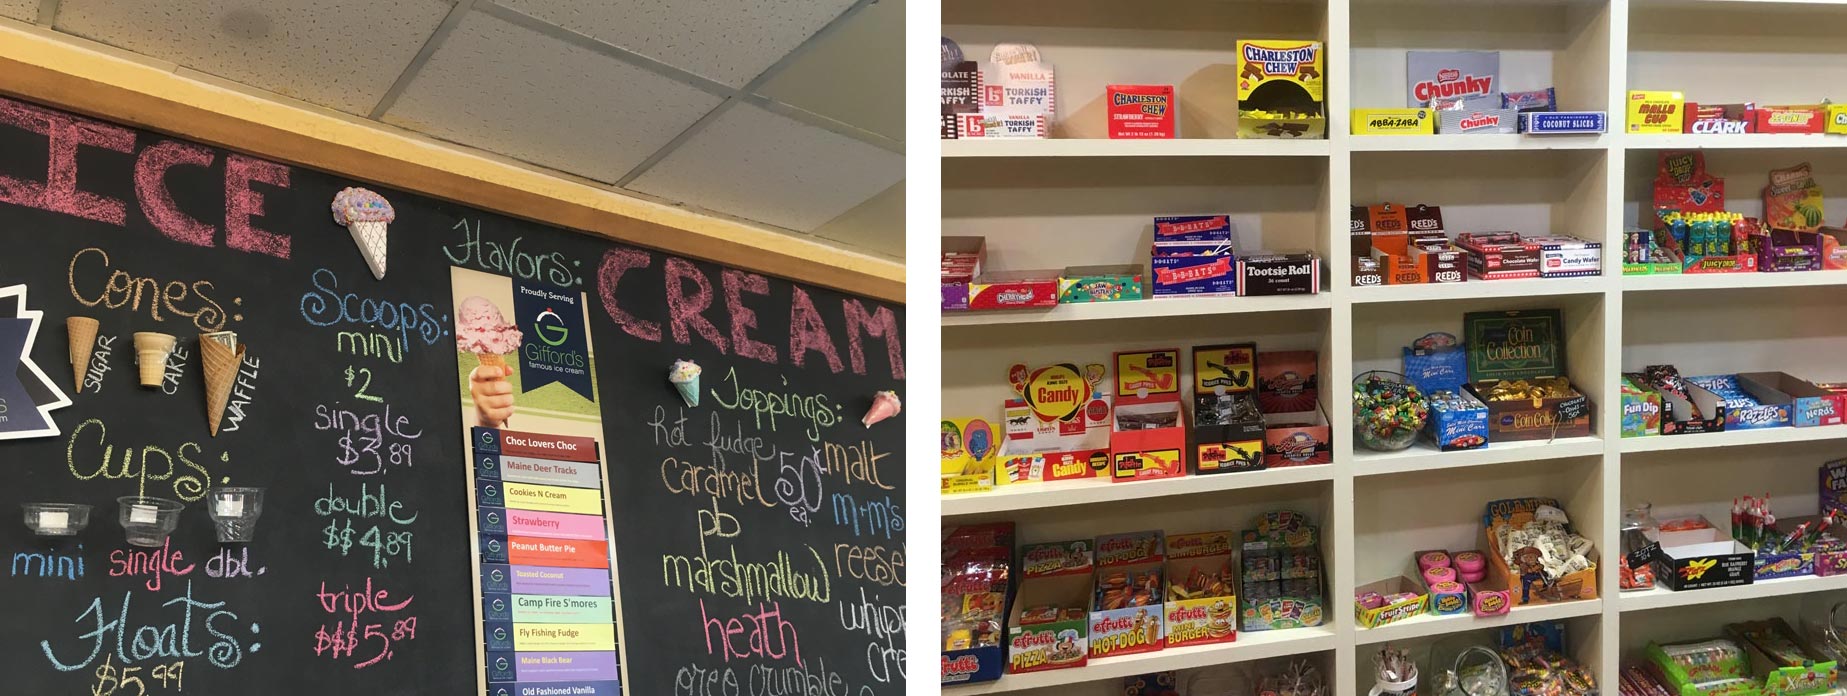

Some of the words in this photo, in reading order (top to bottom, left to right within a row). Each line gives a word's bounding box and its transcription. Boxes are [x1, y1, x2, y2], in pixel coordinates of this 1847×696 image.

[1245, 45, 1315, 62] CHARLESTON
[1009, 72, 1045, 80] VANILLA
[1266, 62, 1298, 74] CHEW
[1005, 88, 1047, 96] TURKISH
[1414, 75, 1492, 101] Chunky
[1009, 97, 1043, 105] TAFFY
[1114, 92, 1167, 106] CHARLESTON
[1141, 104, 1166, 116] CHEW
[1369, 118, 1419, 127] ABBA-ZABA
[1460, 116, 1498, 129] Chunky
[1543, 120, 1571, 128] COCONUT
[1573, 119, 1594, 128] SLICES
[1692, 120, 1749, 134] CLARK
[0, 102, 292, 260] ICE
[1411, 219, 1438, 229] REED'S
[1246, 266, 1288, 277] Tootsie
[1288, 264, 1311, 275] Roll
[1702, 260, 1722, 269] JUICY
[1355, 275, 1382, 285] REED'S
[1435, 271, 1461, 282] REED'S
[68, 246, 244, 333] Cones:
[520, 285, 548, 300] Proudly
[548, 292, 574, 305] Serving
[300, 267, 450, 353] Scoops:
[597, 247, 907, 381] CREAM
[337, 324, 403, 364] mini
[1508, 326, 1534, 345] Coin
[525, 342, 584, 368] Gifford's
[1486, 341, 1541, 361] Collection
[84, 334, 118, 394] SUGAR
[162, 345, 190, 396] CAKE
[528, 361, 553, 371] famous
[554, 365, 564, 373] ice
[565, 366, 585, 375] cream
[344, 364, 384, 403] $2
[222, 354, 261, 433] WAFFLE
[1038, 385, 1079, 406] Candy
[1624, 403, 1642, 415] Fun
[1642, 402, 1659, 415] Dip
[314, 402, 423, 449] single
[1446, 427, 1466, 436] Mini
[1467, 423, 1486, 432] Cars
[1514, 414, 1534, 429] Coin
[505, 435, 527, 448] Choc
[528, 438, 555, 449] Lovers
[556, 440, 577, 451] Choc
[648, 404, 690, 448] hot
[703, 410, 776, 480] fudge
[67, 418, 231, 503] Cups:
[507, 460, 532, 471] Maine
[533, 463, 552, 473] Deer
[553, 465, 578, 475] Tracks
[823, 440, 896, 491] malt
[1052, 460, 1087, 478] Candy
[661, 456, 778, 509] caramel
[509, 487, 537, 498] Cookies
[537, 490, 544, 498] N
[545, 490, 567, 500] Cream
[314, 482, 419, 525] double
[512, 515, 560, 530] Strawberry
[697, 496, 742, 558] pb
[511, 541, 538, 551] Peanut
[539, 542, 563, 552] Butter
[564, 545, 576, 553] Pie
[11, 543, 87, 581] mini
[109, 535, 196, 592] single
[205, 547, 268, 580] dbl.
[1026, 560, 1062, 575] PIZZA
[663, 542, 831, 605] marshmallow
[316, 576, 416, 630] triple
[518, 597, 544, 609] Camp
[545, 598, 562, 608] Fire
[563, 598, 598, 609] S'mores
[1168, 606, 1208, 624] efrutti
[1380, 606, 1401, 620] Fruit
[519, 628, 530, 639] Fly
[531, 629, 557, 638] Fishing
[557, 629, 579, 638] Fudge
[700, 597, 805, 669] heath
[1093, 616, 1134, 634] efrutti
[1013, 629, 1056, 649] efrutti
[1092, 635, 1118, 656] HOT
[1119, 629, 1147, 650] DOG
[1168, 627, 1209, 645] BURGER
[521, 656, 541, 665] Maine
[941, 655, 980, 676] frutti
[1012, 650, 1048, 670] PIZZA
[522, 688, 536, 696] Old
[537, 687, 571, 696] Fashioned
[572, 686, 596, 695] Vanilla
